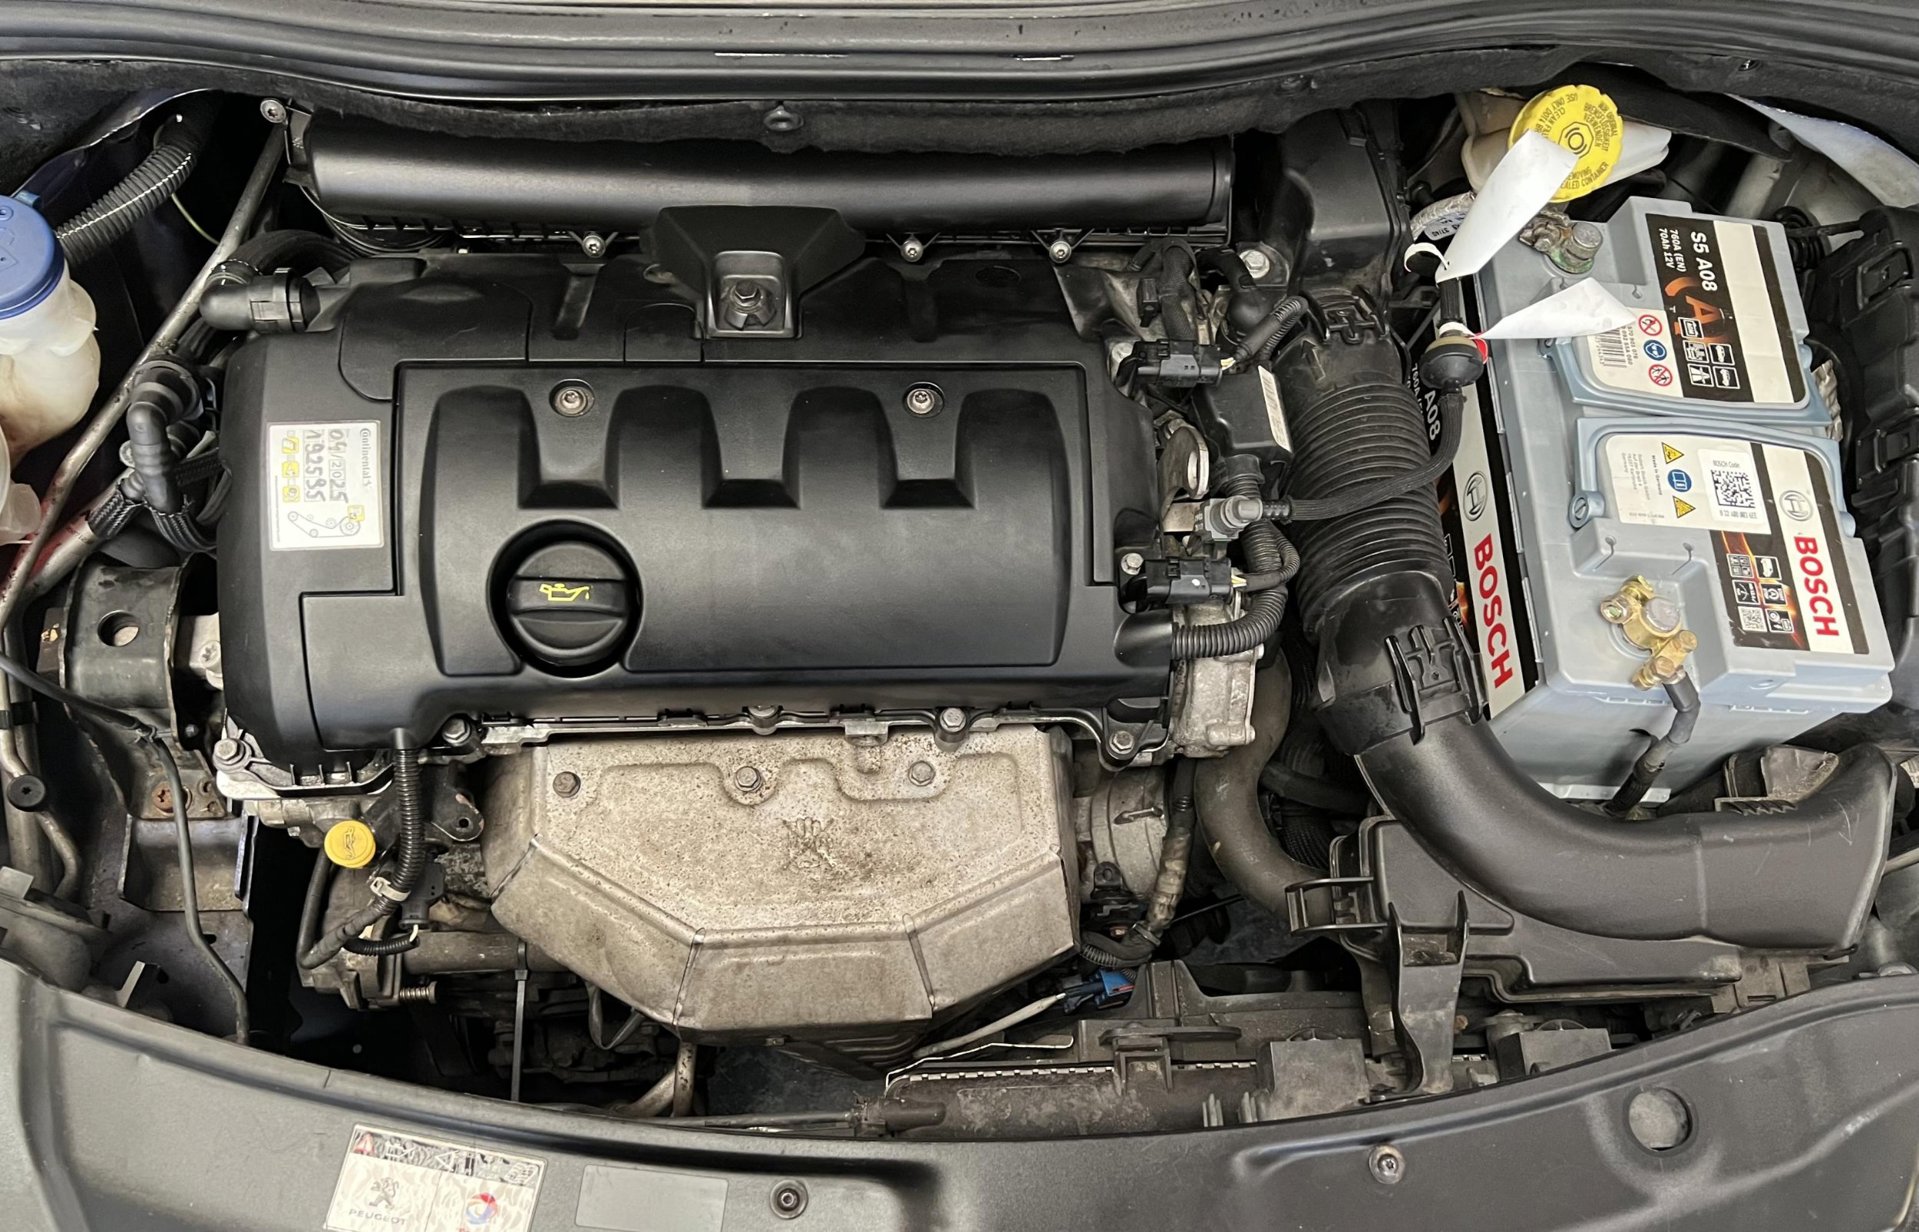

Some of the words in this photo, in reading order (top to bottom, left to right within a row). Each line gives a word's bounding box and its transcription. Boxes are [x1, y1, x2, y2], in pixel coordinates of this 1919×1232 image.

[1659, 228, 1671, 250] 70Ah
[1670, 229, 1682, 251] 760A
[1690, 231, 1710, 254] S5
[1664, 252, 1675, 269] 12V
[1673, 252, 1687, 272] (EN)
[1696, 257, 1718, 291] A08
[1424, 390, 1441, 441] A08
[1794, 535, 1840, 638] BOSCH
[1474, 533, 1513, 689] BOSCH
[349, 1208, 406, 1225] PEUGEOT
